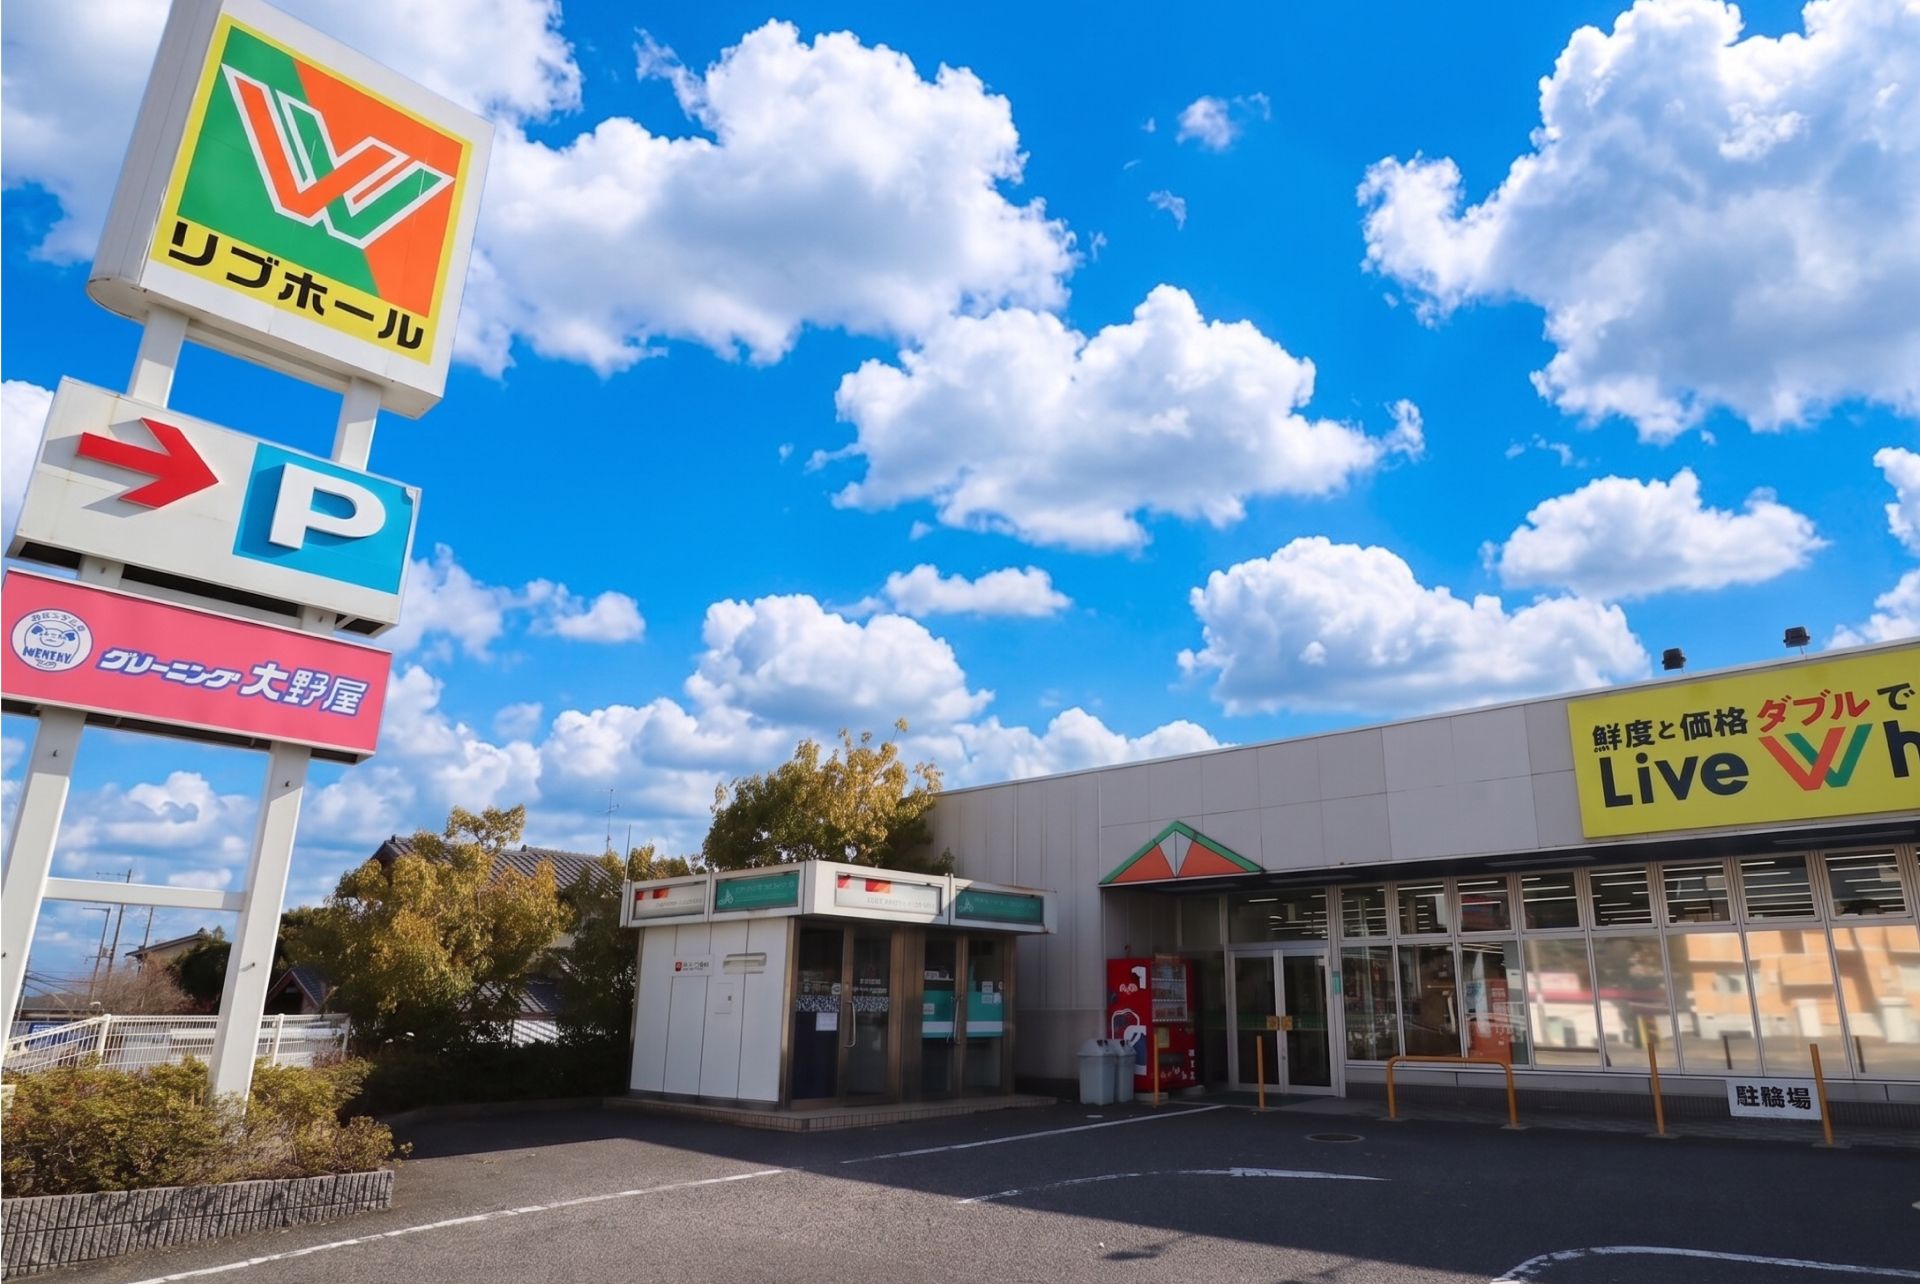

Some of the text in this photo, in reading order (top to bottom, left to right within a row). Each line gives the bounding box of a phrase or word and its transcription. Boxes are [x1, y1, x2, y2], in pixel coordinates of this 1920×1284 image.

[167, 221, 425, 351] リブホール
[268, 461, 387, 550] P
[1599, 752, 1749, 808] Live
